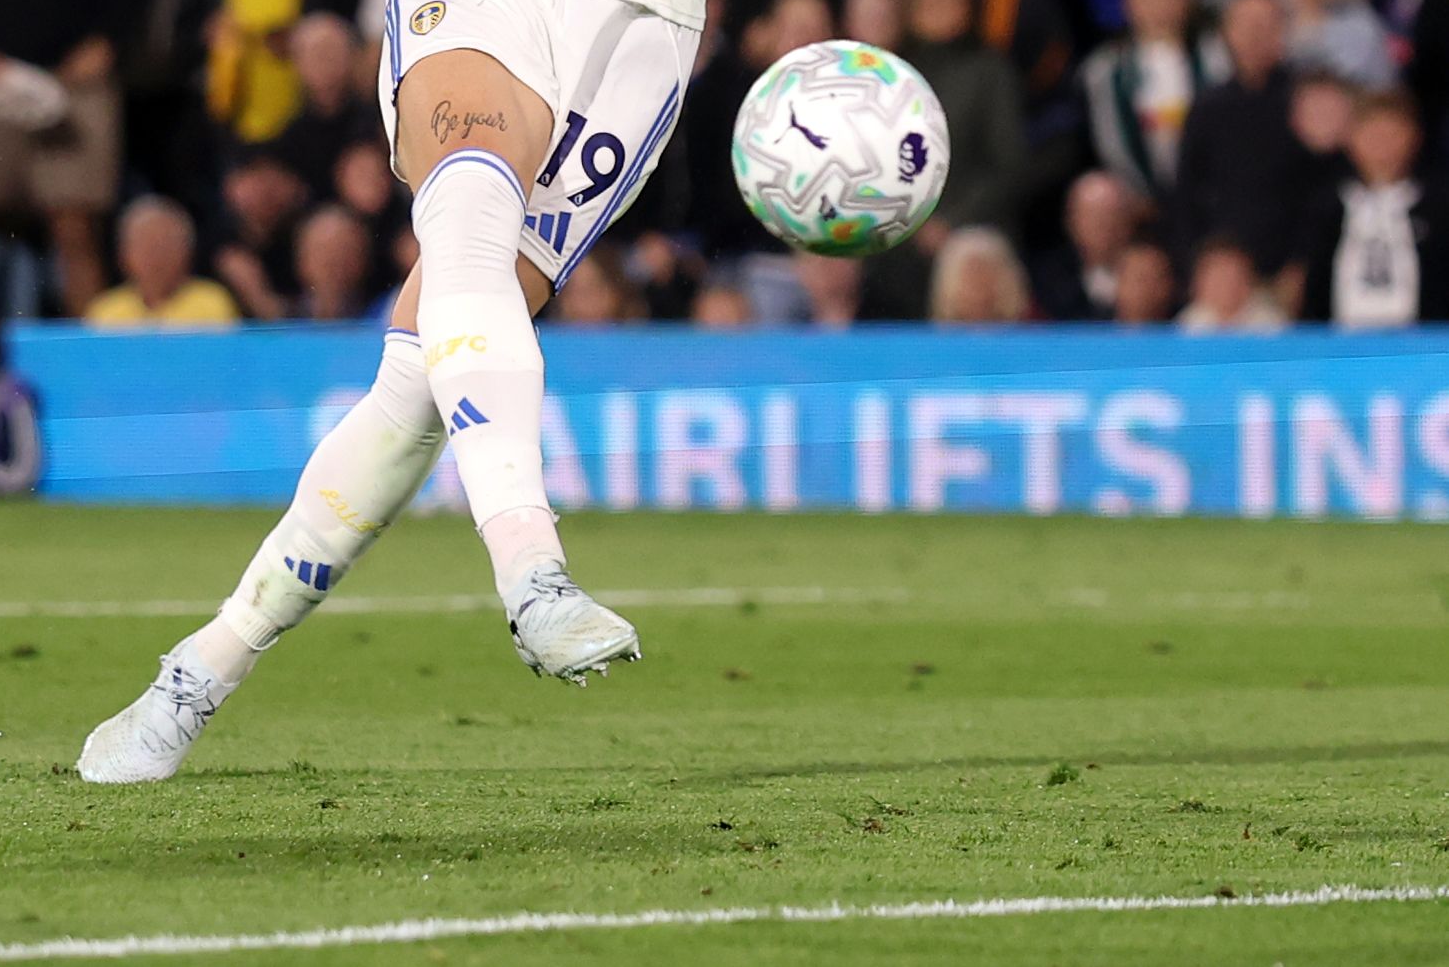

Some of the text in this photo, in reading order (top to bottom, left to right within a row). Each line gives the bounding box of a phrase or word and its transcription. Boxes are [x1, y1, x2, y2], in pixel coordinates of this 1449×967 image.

[431, 100, 508, 145] Be your
[536, 110, 625, 207] 19
